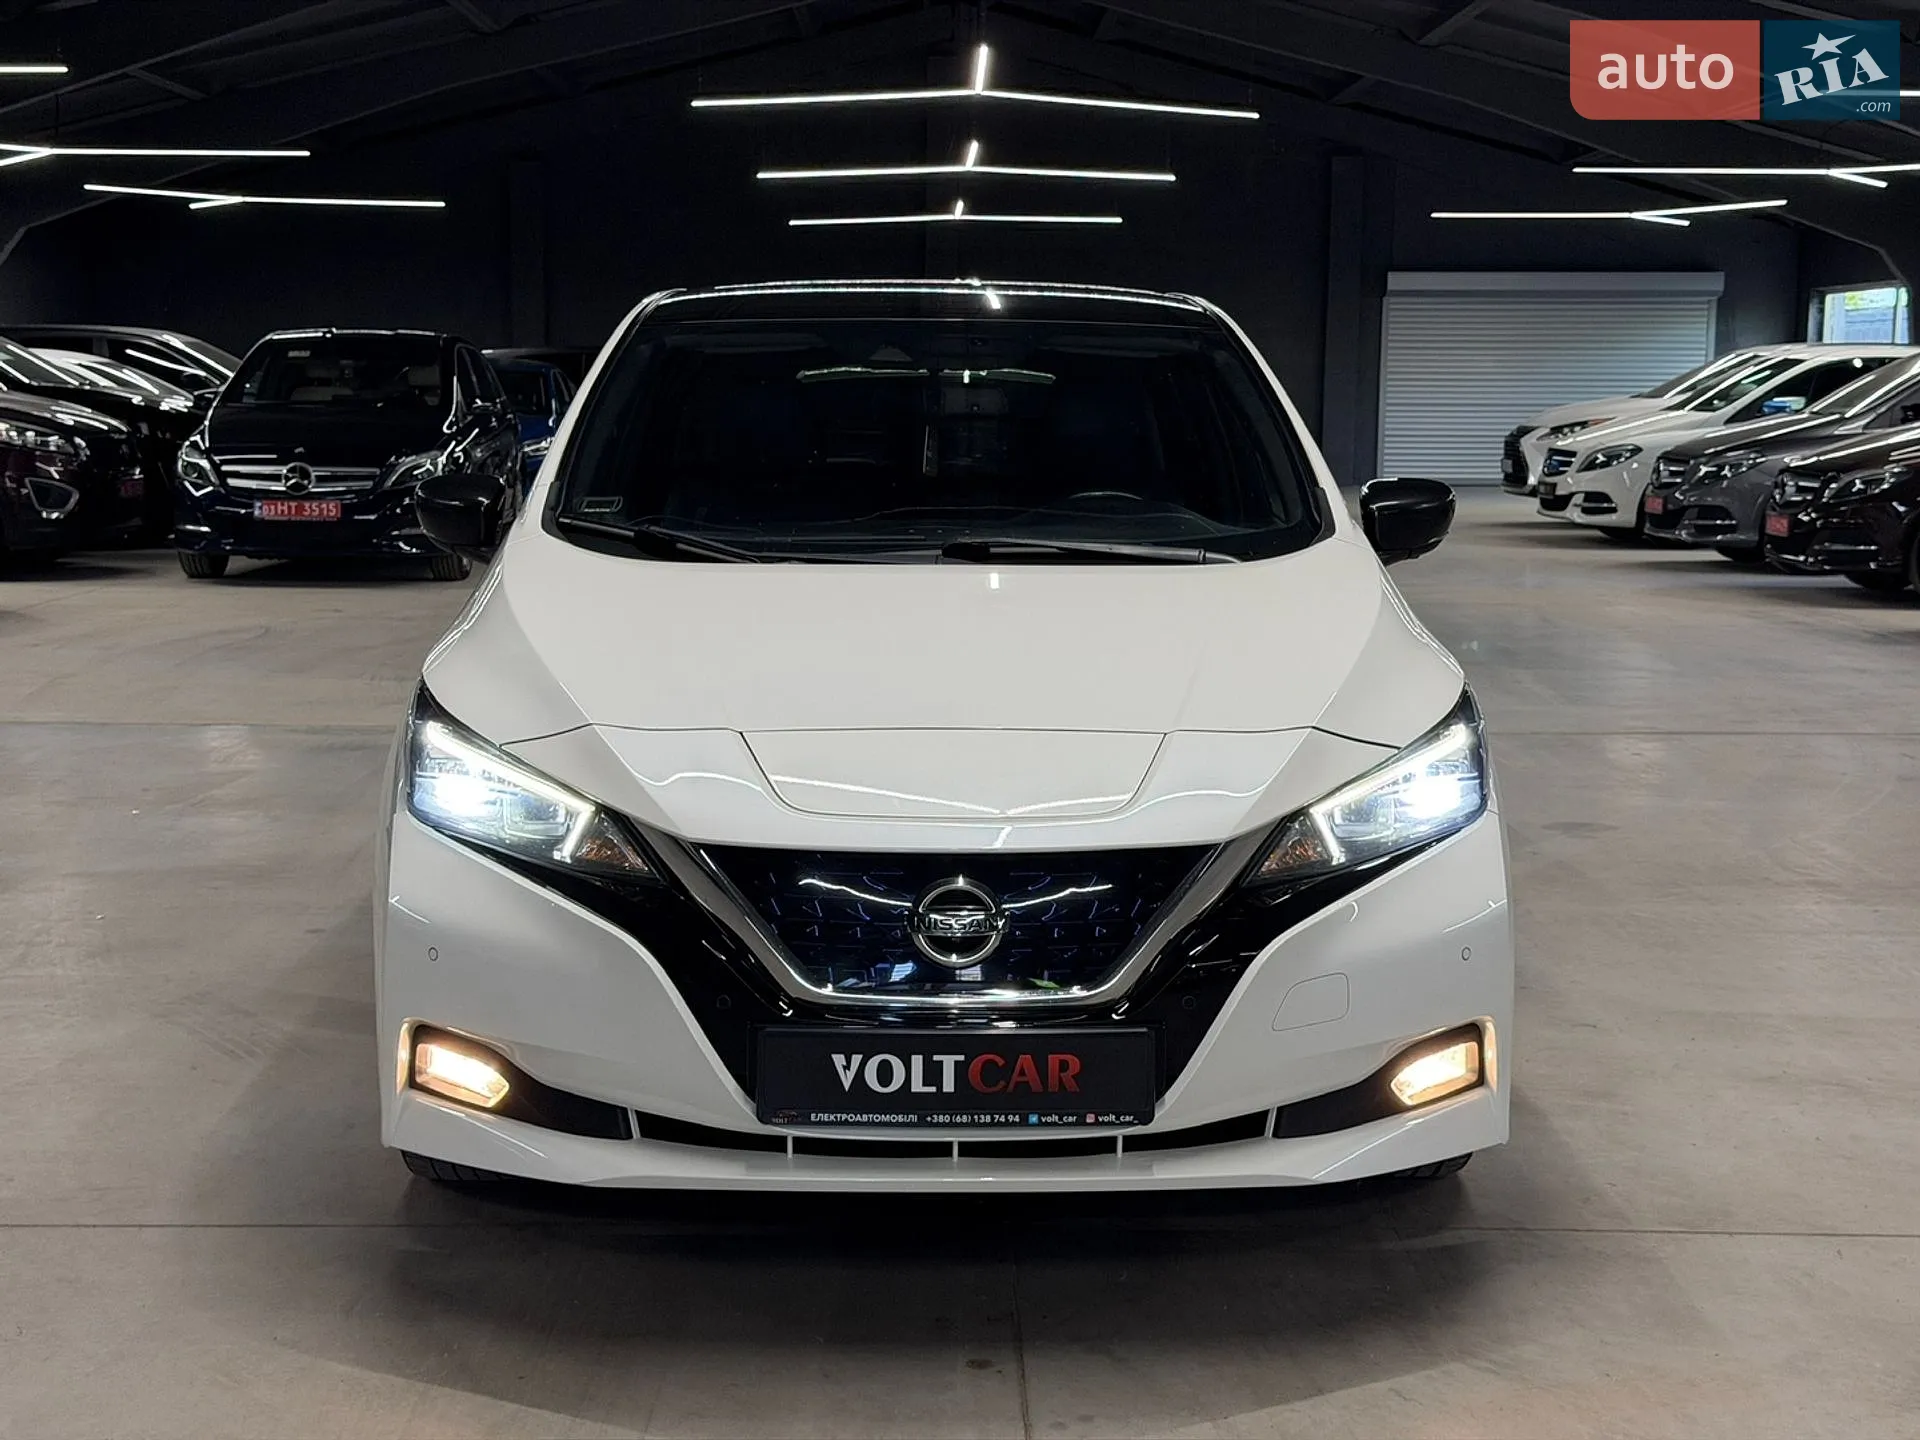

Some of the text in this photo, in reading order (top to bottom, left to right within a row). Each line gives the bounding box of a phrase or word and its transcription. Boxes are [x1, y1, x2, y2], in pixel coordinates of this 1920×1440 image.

[913, 915, 1005, 933] NISSAN
[810, 1112, 918, 1123] ЕЛЕКТРОАВТОМОБІЛІ
[926, 1114, 951, 1123] +380
[952, 1114, 972, 1124] (68)
[973, 1114, 991, 1123] 138
[993, 1114, 1006, 1123] 74
[1007, 1114, 1020, 1123] 94
[1041, 1113, 1077, 1124] volt_car
